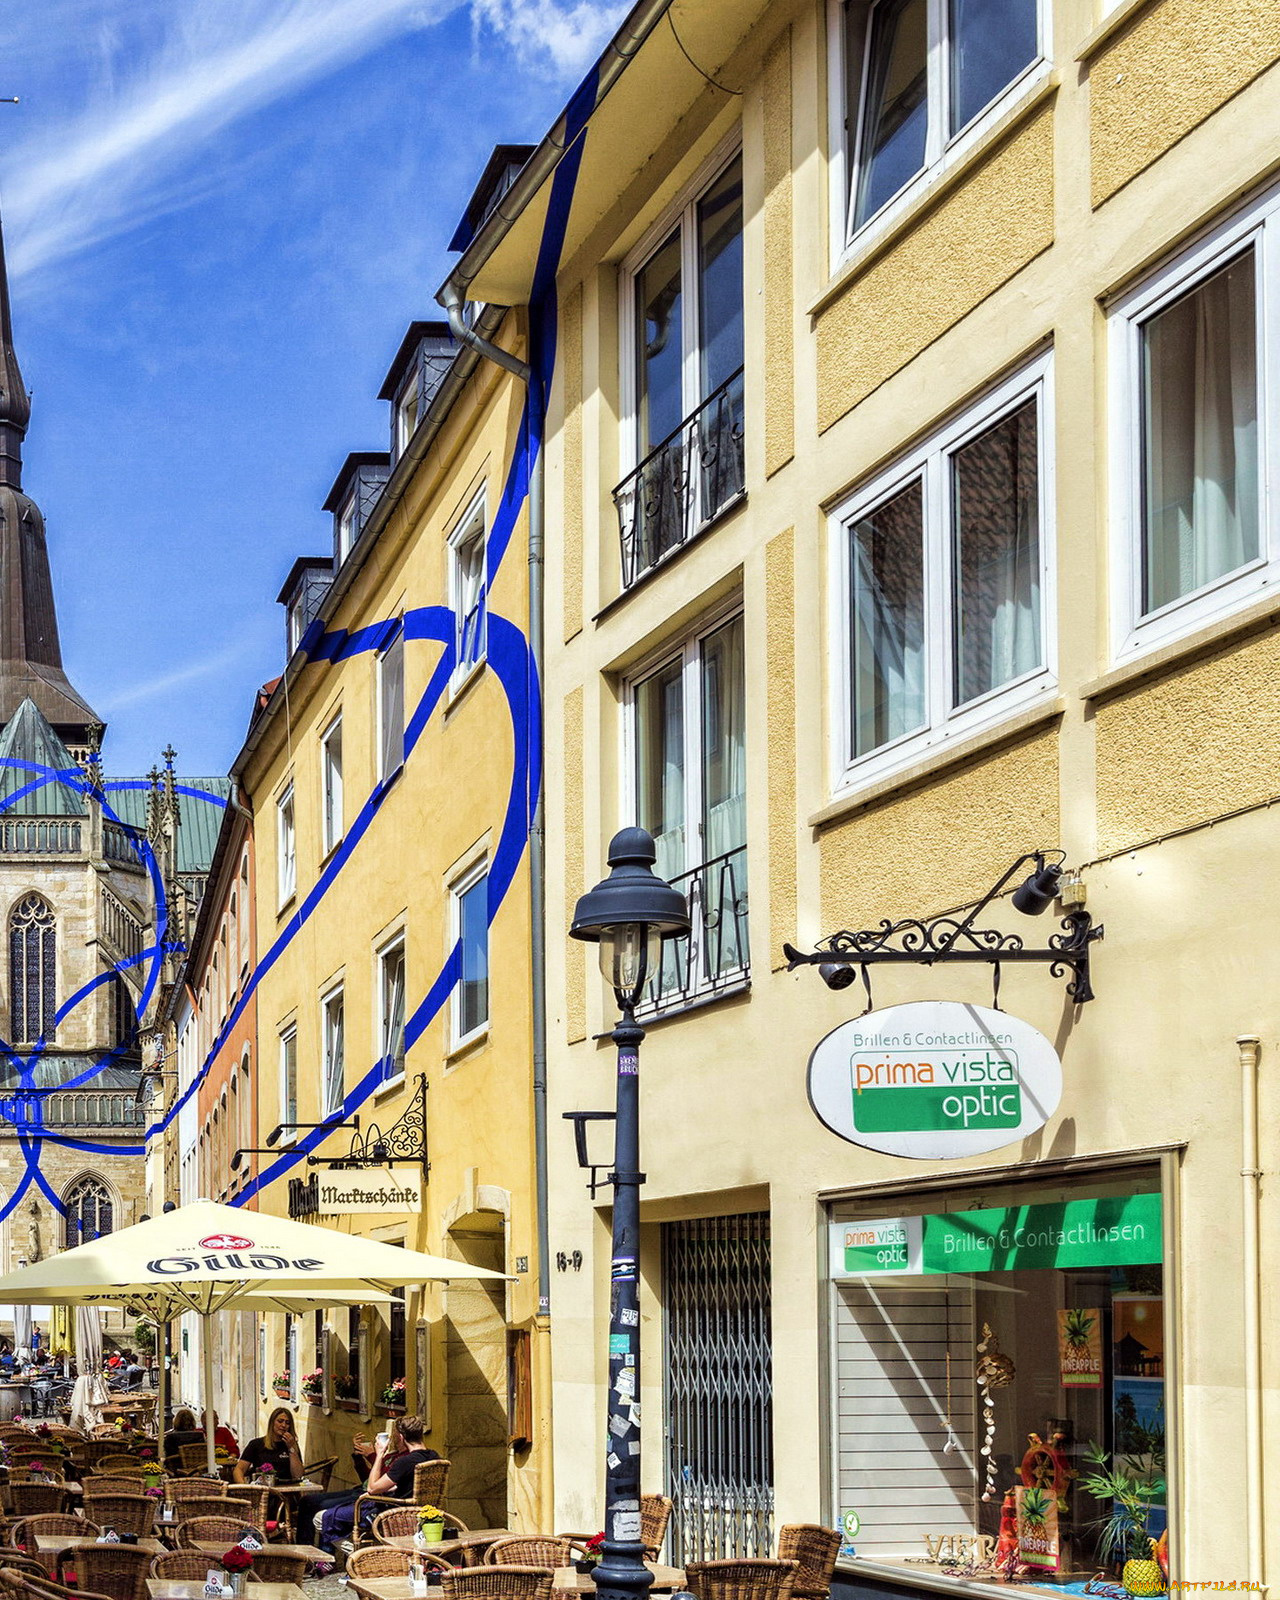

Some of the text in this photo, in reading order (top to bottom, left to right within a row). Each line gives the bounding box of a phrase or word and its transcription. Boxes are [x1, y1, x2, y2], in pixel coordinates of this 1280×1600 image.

[854, 1032, 1013, 1047] Brillen & Contactlinsen
[856, 1052, 1013, 1095] prima vista
[942, 1085, 1017, 1127] optic
[321, 1186, 419, 1207] Marktschänke
[845, 1225, 907, 1250] prima vista
[943, 1222, 1145, 1253] Brillen & Contactlinsen
[146, 1254, 325, 1275] Gilde
[876, 1245, 907, 1268] optic
